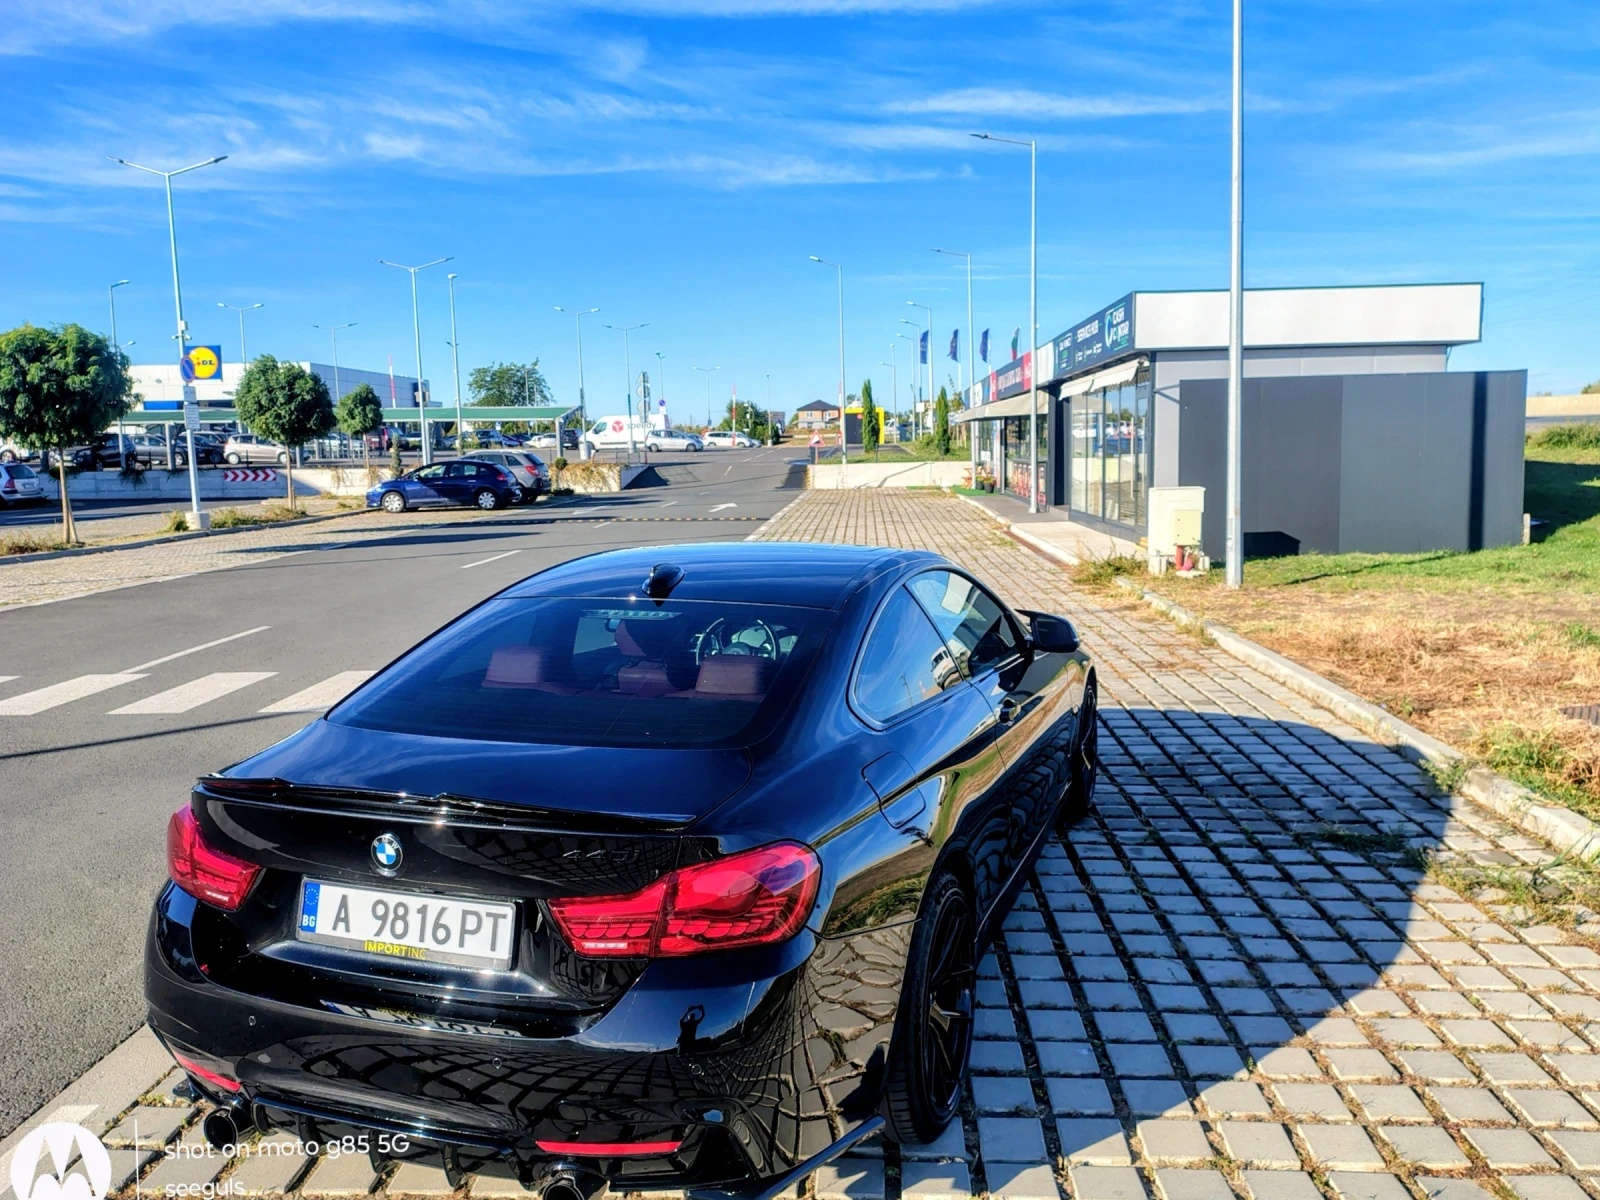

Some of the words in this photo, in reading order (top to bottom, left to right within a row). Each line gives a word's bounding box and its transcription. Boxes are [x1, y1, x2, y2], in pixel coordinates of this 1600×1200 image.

[373, 836, 400, 850] BMW
[332, 894, 350, 932] A
[302, 914, 315, 928] BG
